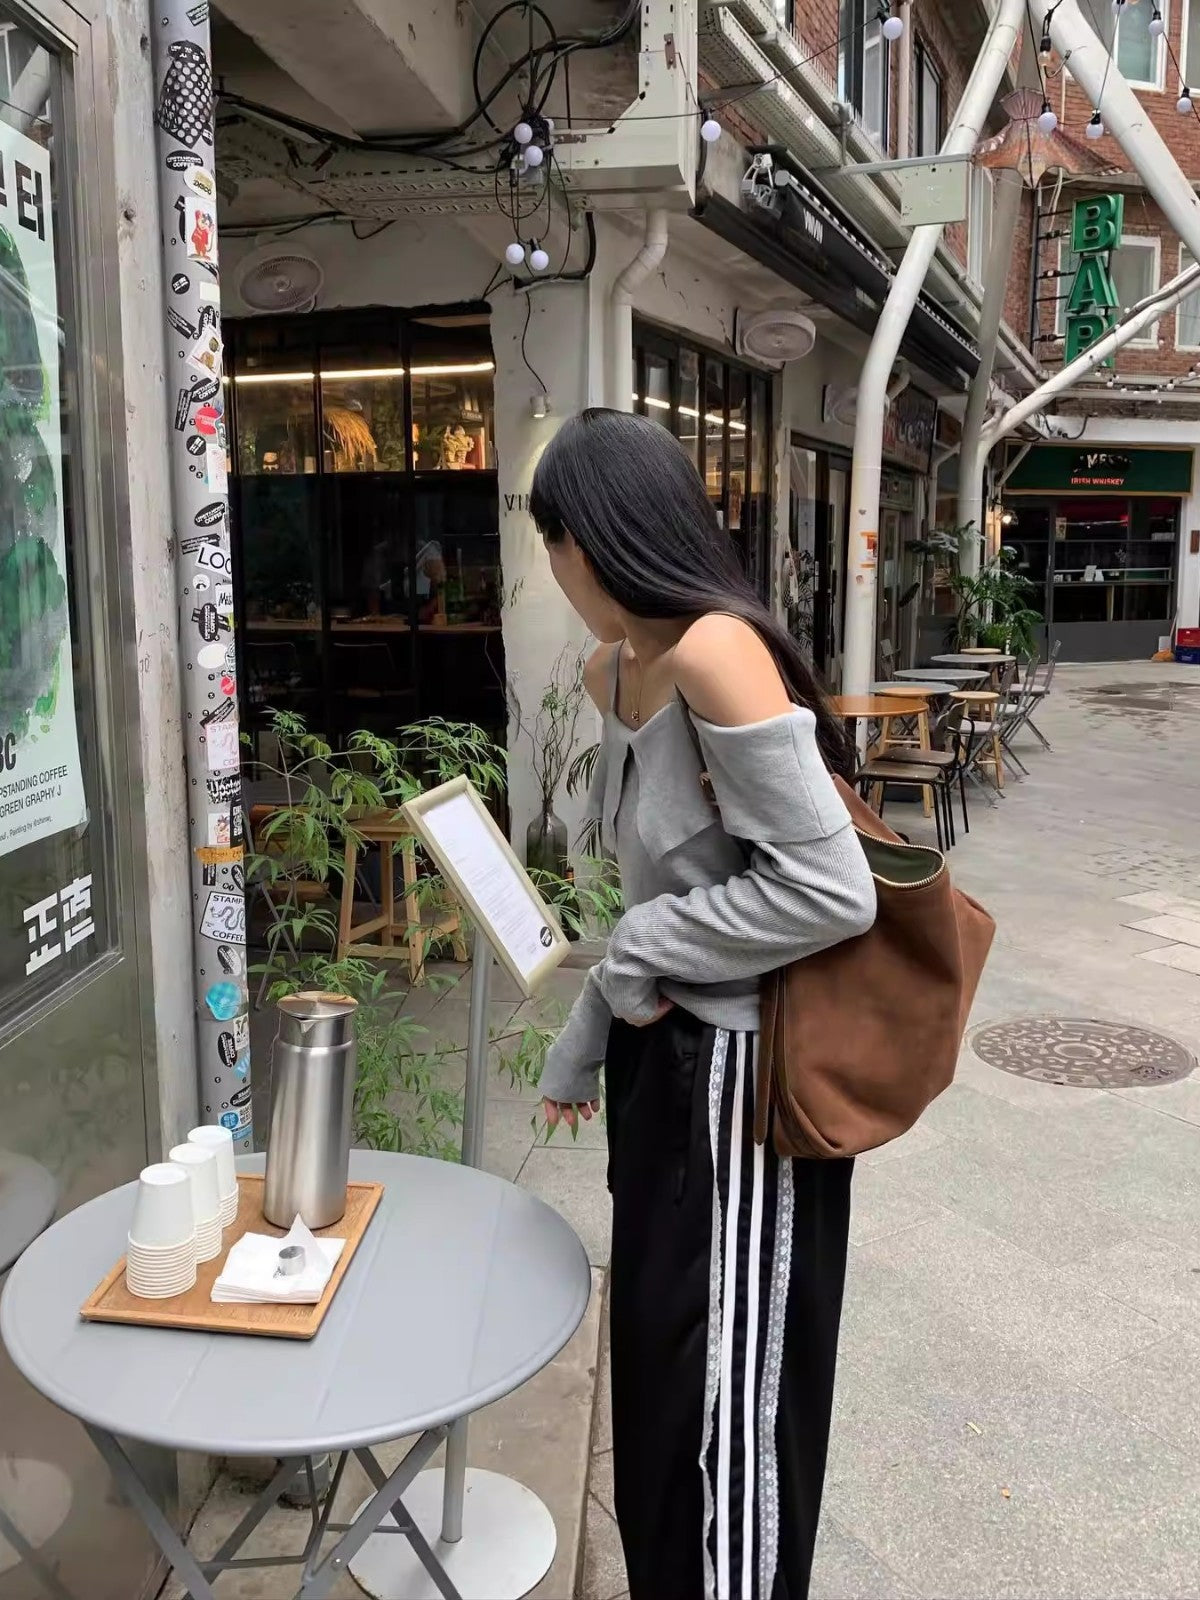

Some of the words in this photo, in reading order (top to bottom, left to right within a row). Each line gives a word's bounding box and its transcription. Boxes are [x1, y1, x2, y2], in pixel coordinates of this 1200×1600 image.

[1064, 194, 1124, 368] BAR
[1071, 477, 1091, 485] IRISH
[1092, 478, 1125, 486] WHISKEY
[39, 765, 68, 784] COFFEE
[0, 798, 24, 818] GREEN
[25, 787, 55, 808] GRAPHY
[57, 785, 62, 796] J
